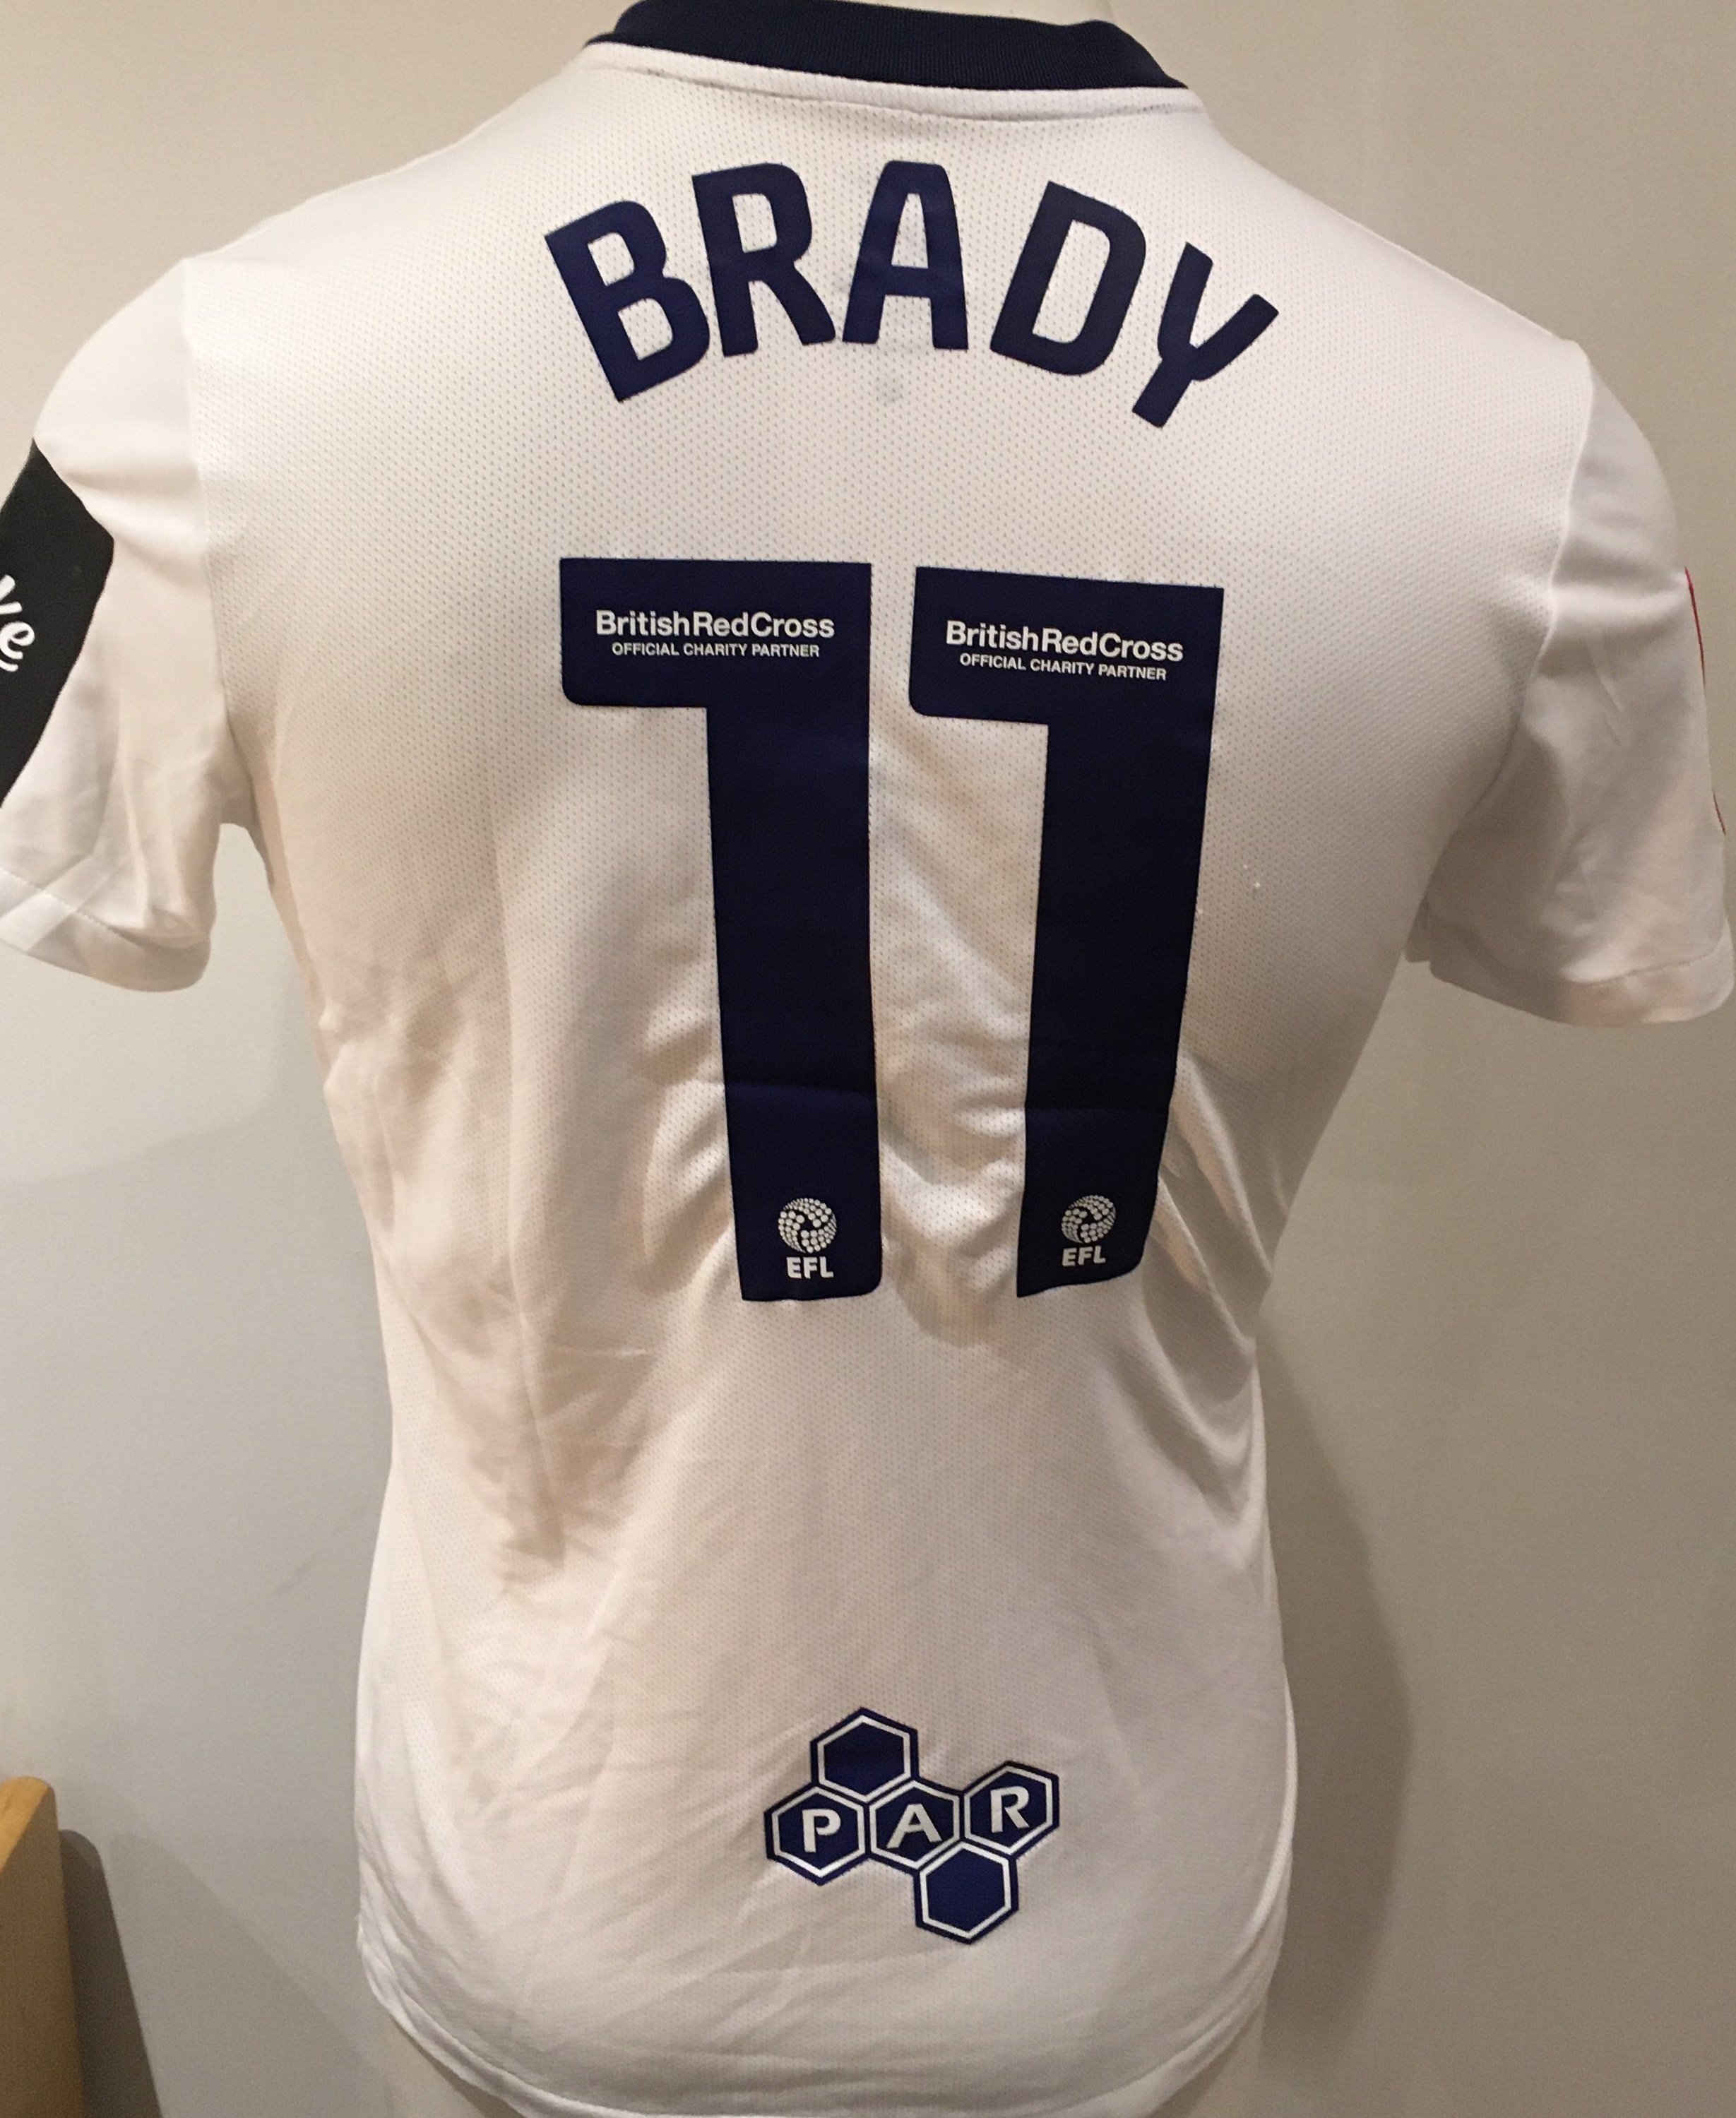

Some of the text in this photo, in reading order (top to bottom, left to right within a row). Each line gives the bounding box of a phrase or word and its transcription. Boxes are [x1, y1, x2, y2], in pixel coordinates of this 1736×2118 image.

[545, 160, 1278, 428] BRADY
[596, 609, 835, 638] BritishRedCross
[612, 642, 820, 658] OFFICIAL CHARITY PARTNER
[946, 619, 1184, 662] BritishRedCross
[959, 653, 1167, 681] OFFICIAL CHARITY PARTNER
[559, 558, 1224, 1302] 11
[786, 1256, 834, 1279] EFL
[1063, 1246, 1105, 1266] EFL
[802, 1785, 1030, 1853] PAR
